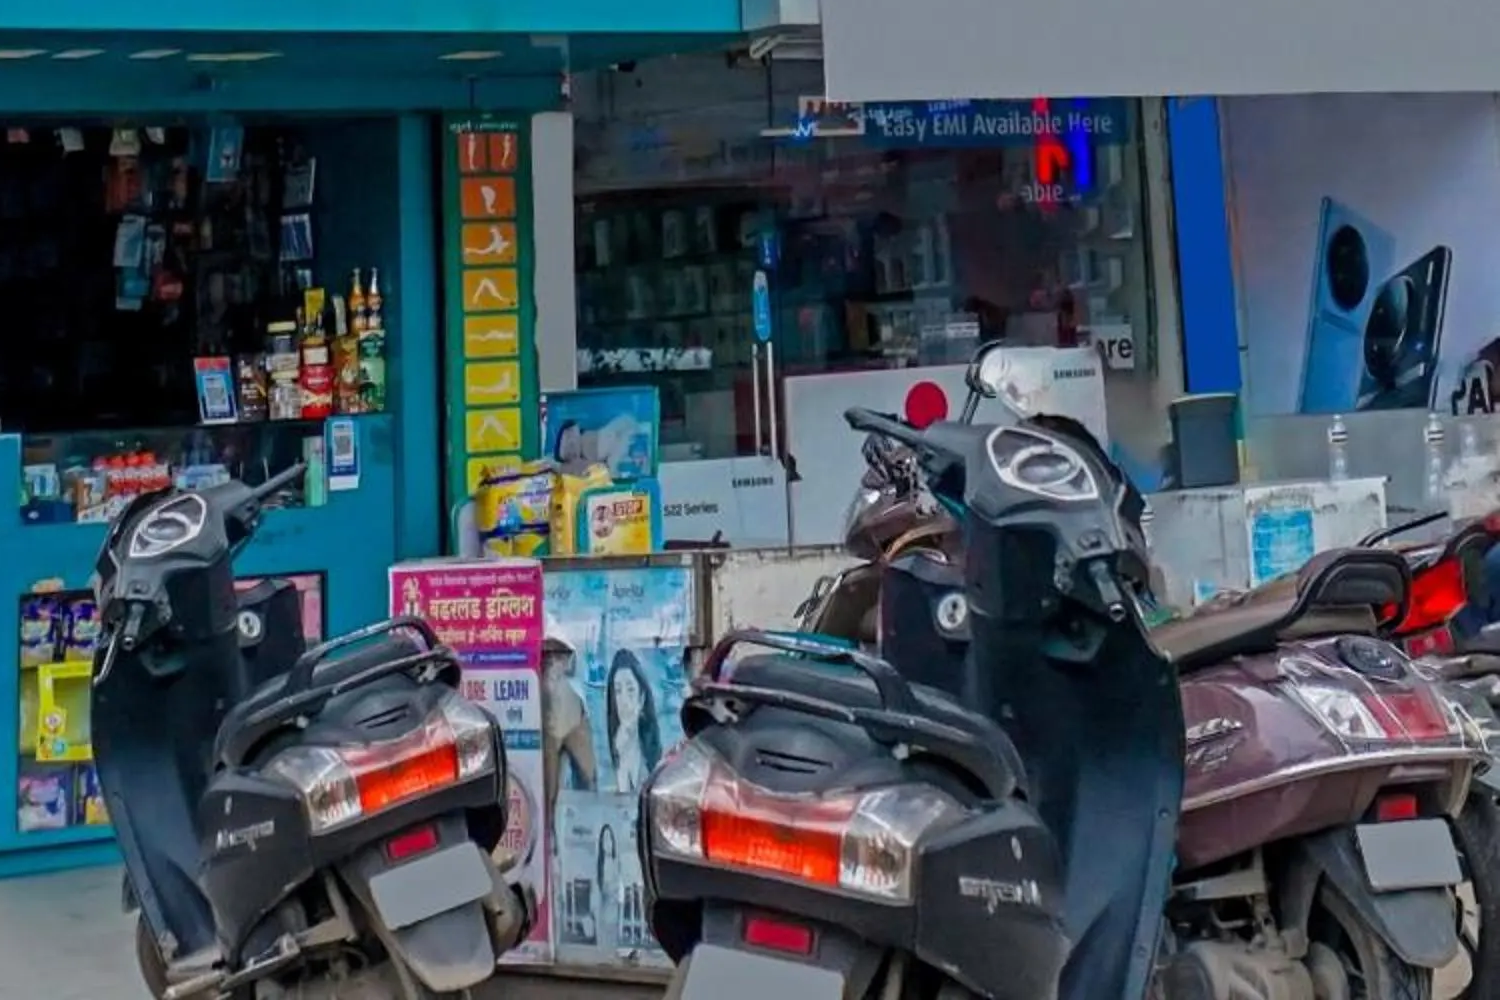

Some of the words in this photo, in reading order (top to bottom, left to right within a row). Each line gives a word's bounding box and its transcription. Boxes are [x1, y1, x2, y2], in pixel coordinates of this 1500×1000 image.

[883, 117, 927, 142] Easy
[933, 113, 968, 136] EMI
[973, 110, 1062, 136] Available
[1068, 111, 1113, 134] Here
[494, 679, 529, 701] LEARN
